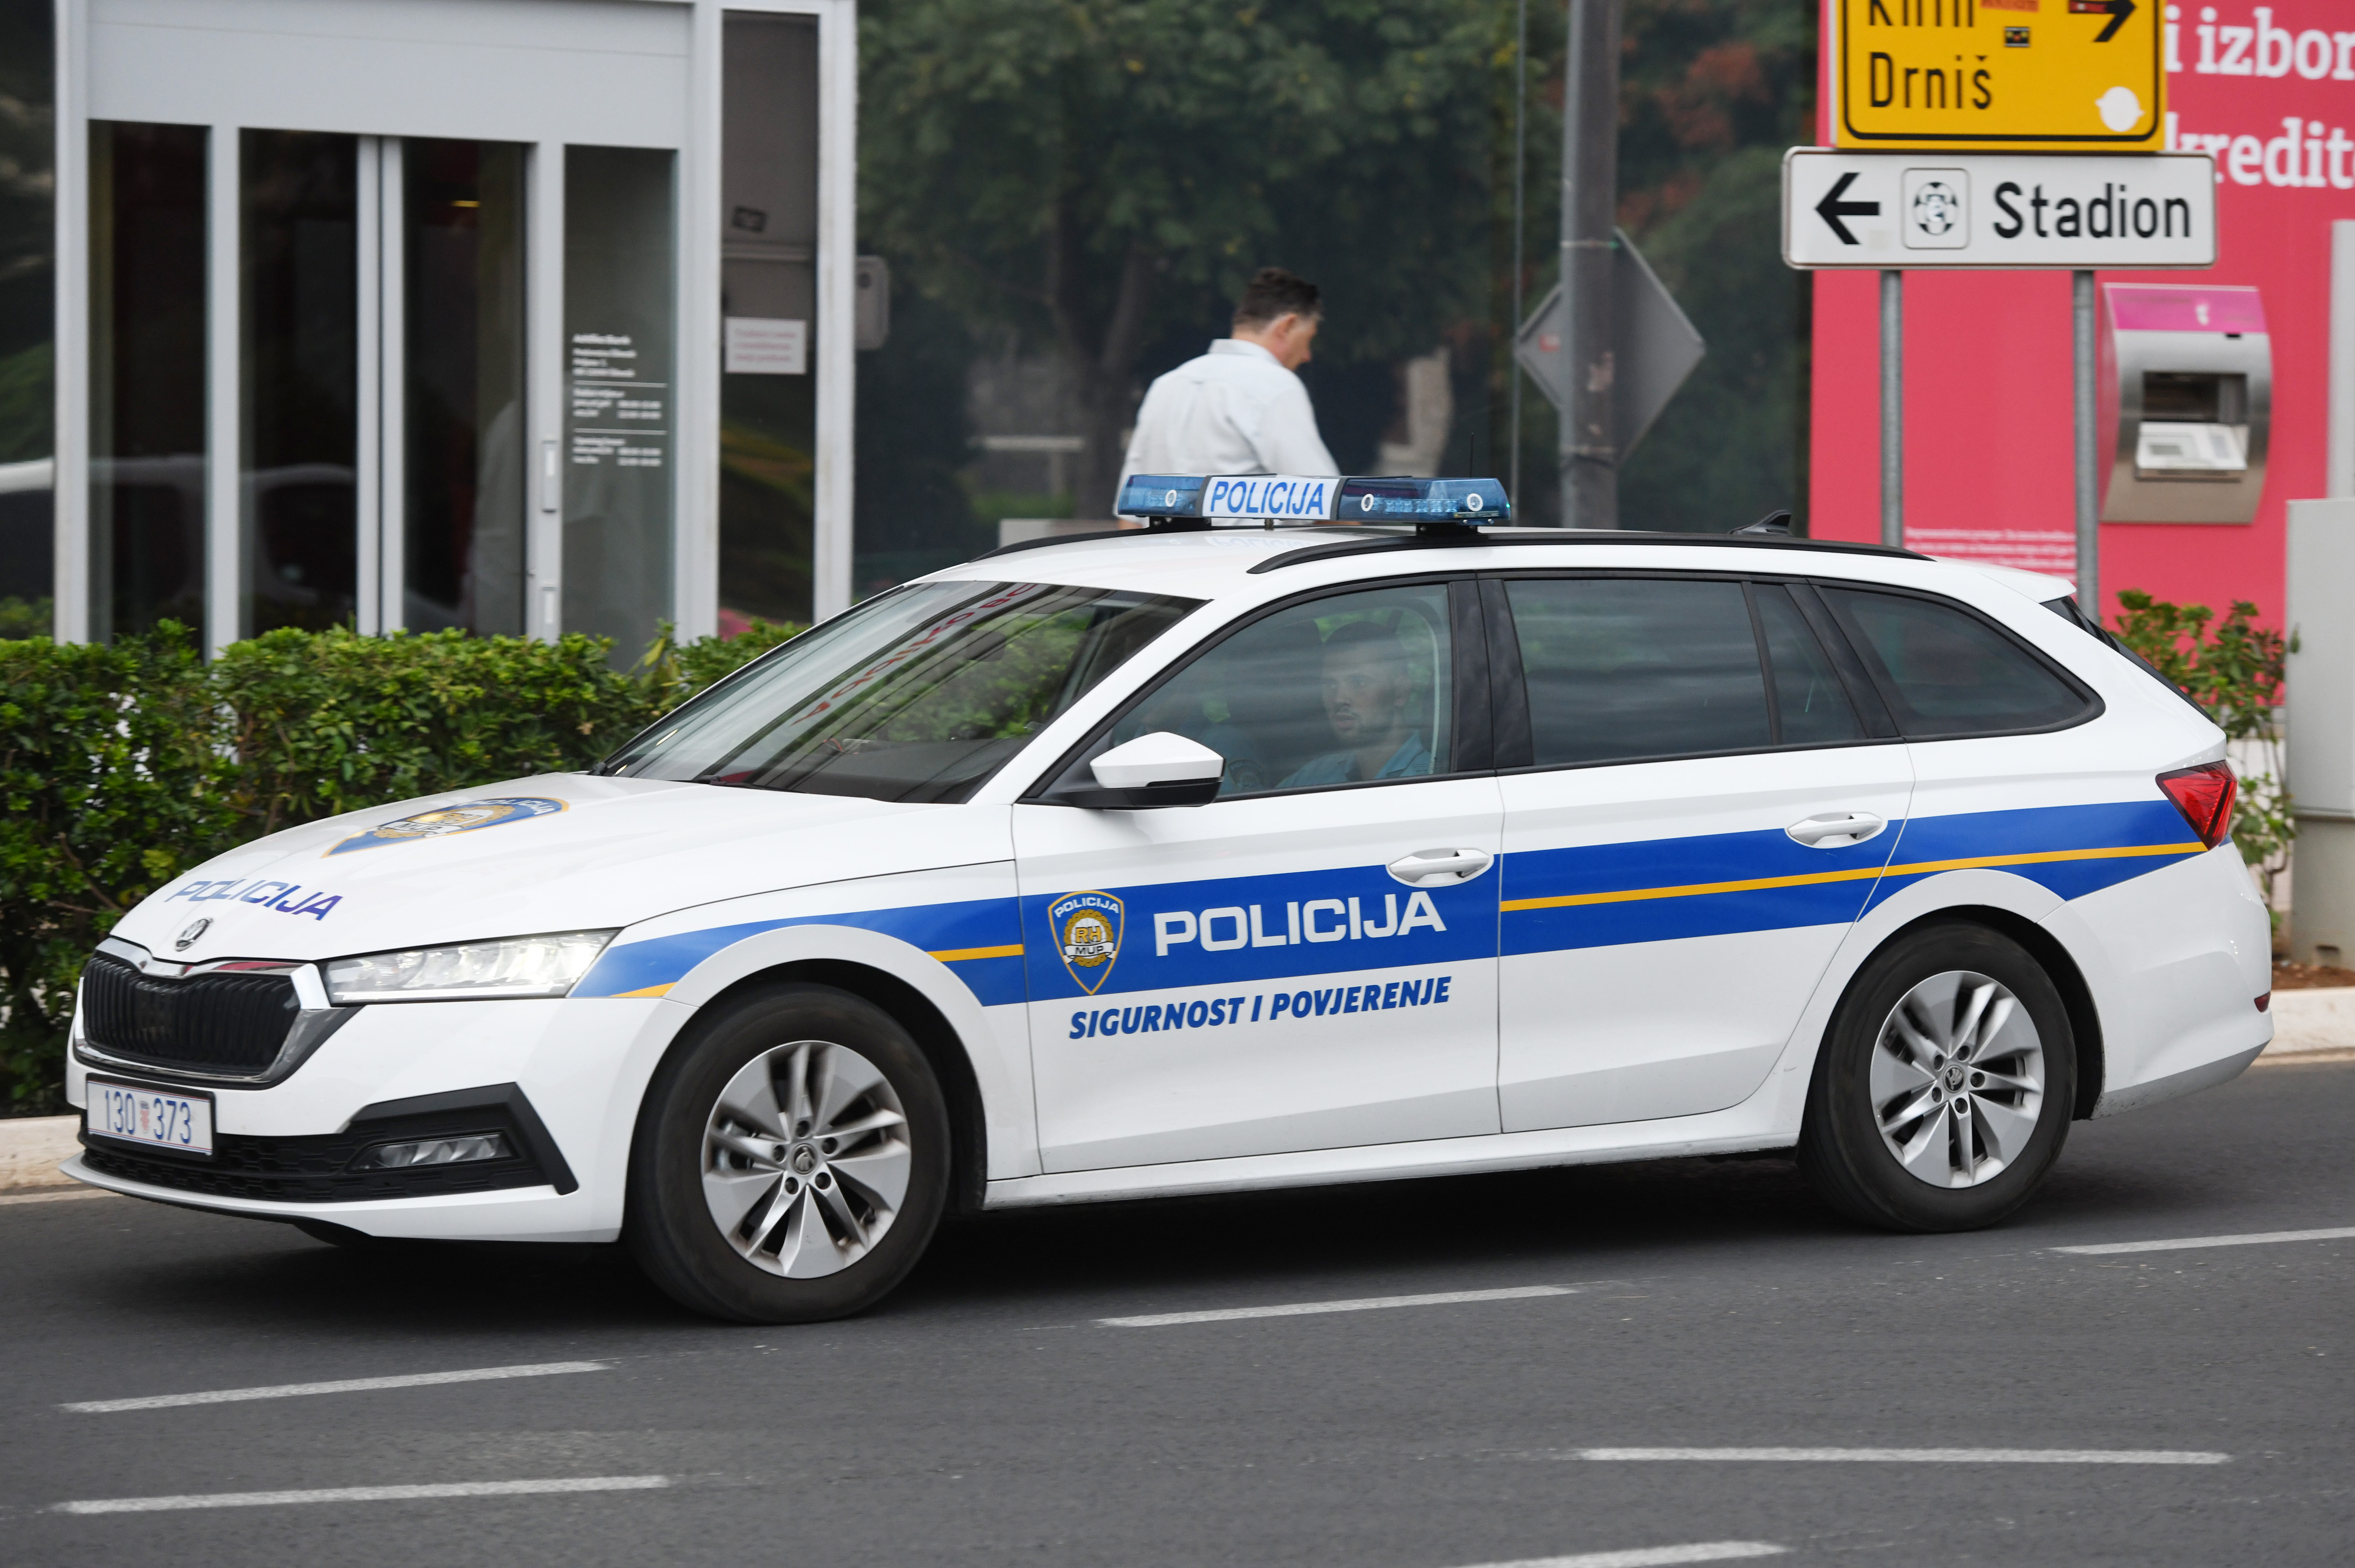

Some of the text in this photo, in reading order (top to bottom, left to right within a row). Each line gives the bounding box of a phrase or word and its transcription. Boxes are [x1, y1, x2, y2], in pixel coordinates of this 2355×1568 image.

[1870, 51, 1991, 109] Drniš
[2165, 111, 2355, 189] kredit
[1993, 181, 2190, 238] Stadion
[1210, 481, 1324, 515] POLICIJA
[164, 879, 343, 921] POLICIJA
[1054, 897, 1119, 918] POLICIJA
[1154, 891, 1447, 957] POLICIJA
[1075, 926, 1102, 944] RH
[1075, 945, 1103, 955] MUP
[1069, 976, 1452, 1039] SIGURNOST I POVJERENJE
[105, 1090, 192, 1144] 130 373
